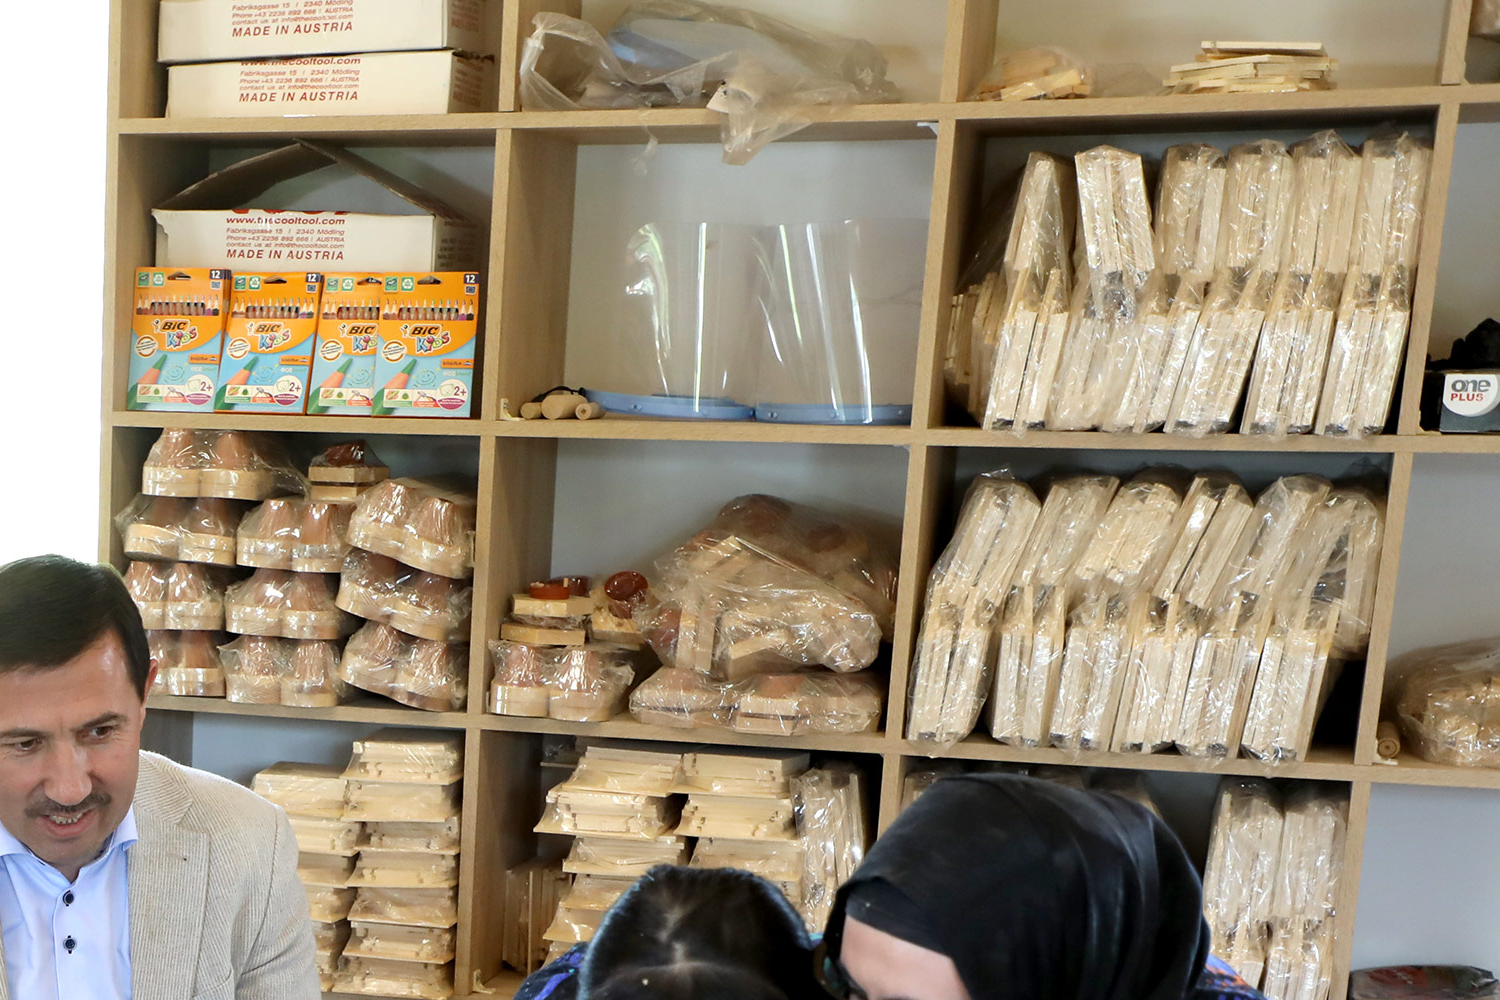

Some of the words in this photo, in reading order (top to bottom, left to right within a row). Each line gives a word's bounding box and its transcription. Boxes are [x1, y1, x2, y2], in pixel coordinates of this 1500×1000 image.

[232, 26, 270, 37] MADE
[275, 25, 289, 35] IN
[293, 21, 353, 34] AUSTRIA
[239, 92, 277, 102] MADE
[282, 92, 295, 101] IN
[299, 91, 358, 101] AUSTRIA
[226, 249, 264, 258] MADE
[268, 249, 282, 259] IN
[286, 250, 344, 260] AUSTRIA
[211, 270, 220, 279] 12
[307, 273, 316, 282] 12
[465, 275, 475, 283] 12
[162, 321, 187, 331] BIC
[256, 324, 281, 333] BIC
[349, 326, 375, 335] BIC
[411, 326, 438, 335] BIC
[200, 381, 212, 392] 2+
[289, 382, 301, 392] 2+
[1451, 379, 1491, 392] one
[453, 385, 466, 397] 2+
[1451, 393, 1484, 402] PLUS
